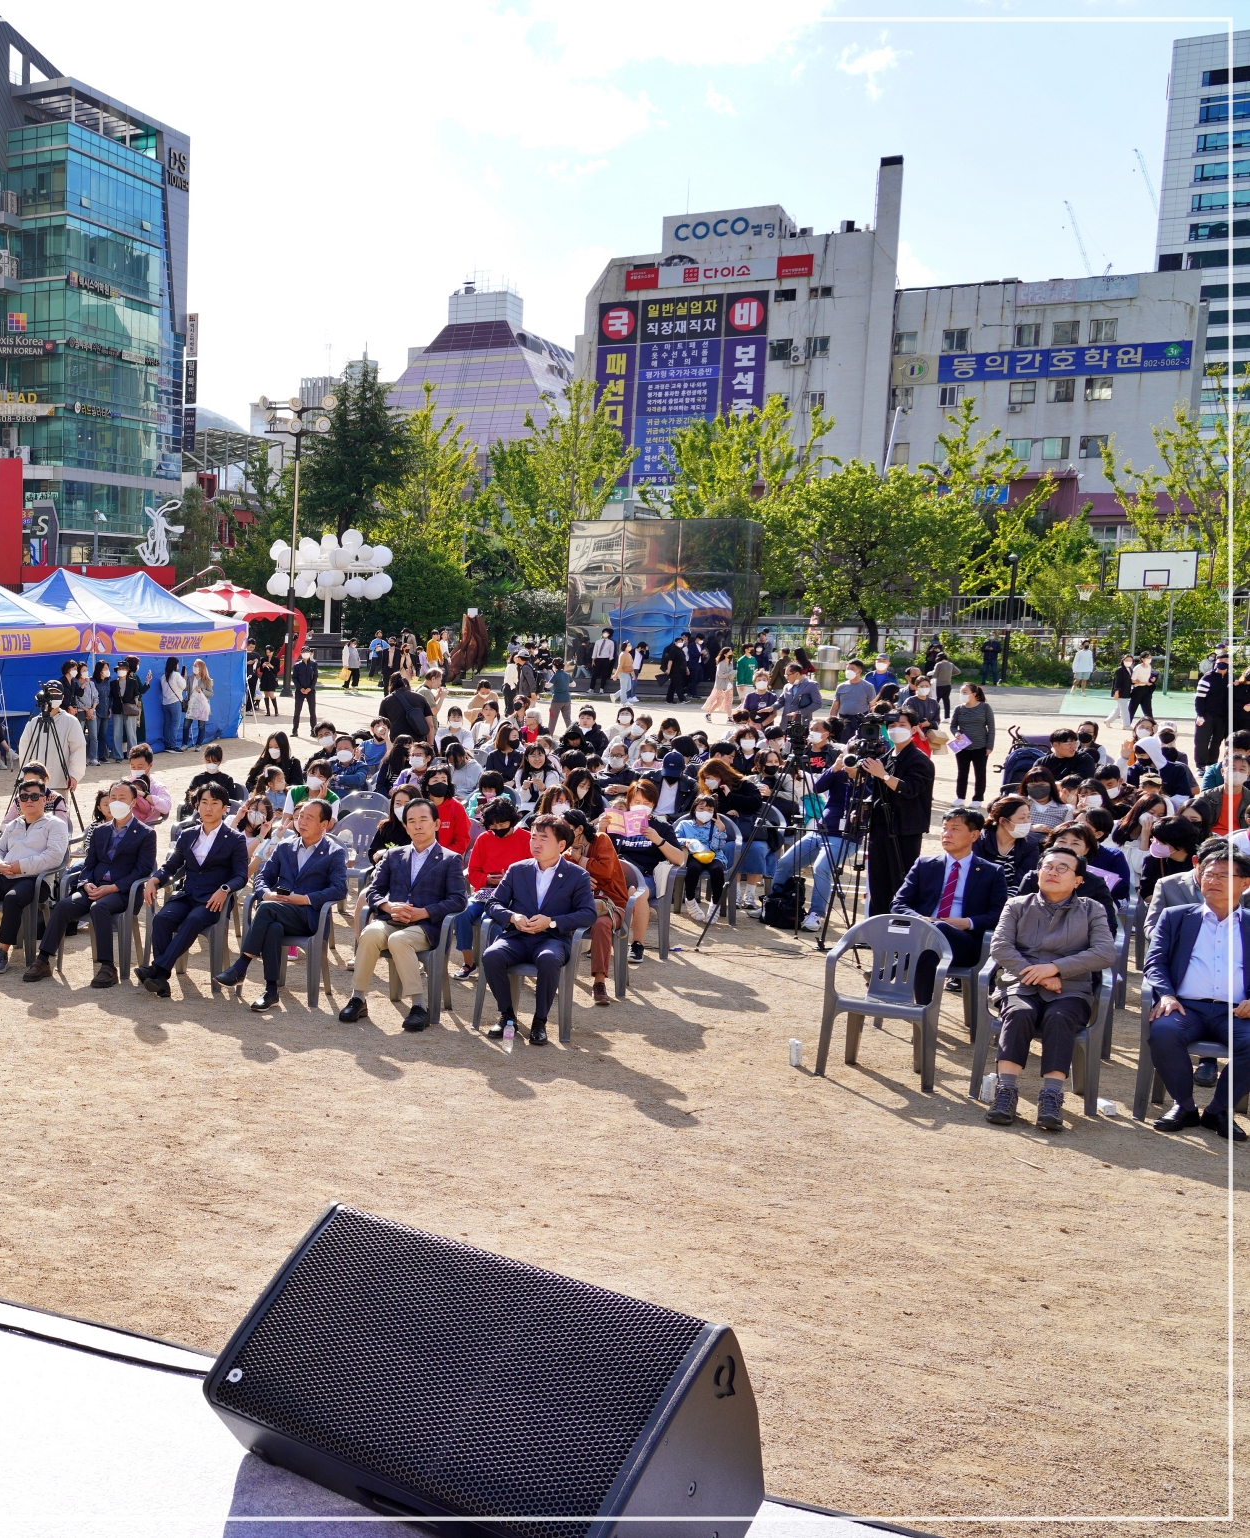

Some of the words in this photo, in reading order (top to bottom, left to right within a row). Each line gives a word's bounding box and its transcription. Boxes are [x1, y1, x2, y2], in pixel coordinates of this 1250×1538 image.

[170, 147, 187, 174] DS
[168, 170, 189, 192] TOWER
[674, 217, 749, 241] COCO
[751, 223, 775, 239] 빌딩
[703, 265, 750, 279] 다이소
[647, 300, 718, 318] 일반실업자
[734, 302, 758, 326] 비
[608, 311, 629, 336] 국
[646, 318, 717, 336] 직장재직자
[15, 335, 43, 346] Korea
[13, 347, 43, 355] KOREAN
[1168, 346, 1180, 356] 3F
[951, 346, 1143, 379] 동의간호학원
[668, 367, 713, 377] 국가자격증반
[732, 345, 756, 422] 보석주
[1, 633, 31, 651] 대기실
[159, 635, 181, 650] 출연자
[181, 635, 203, 650] 대기실
